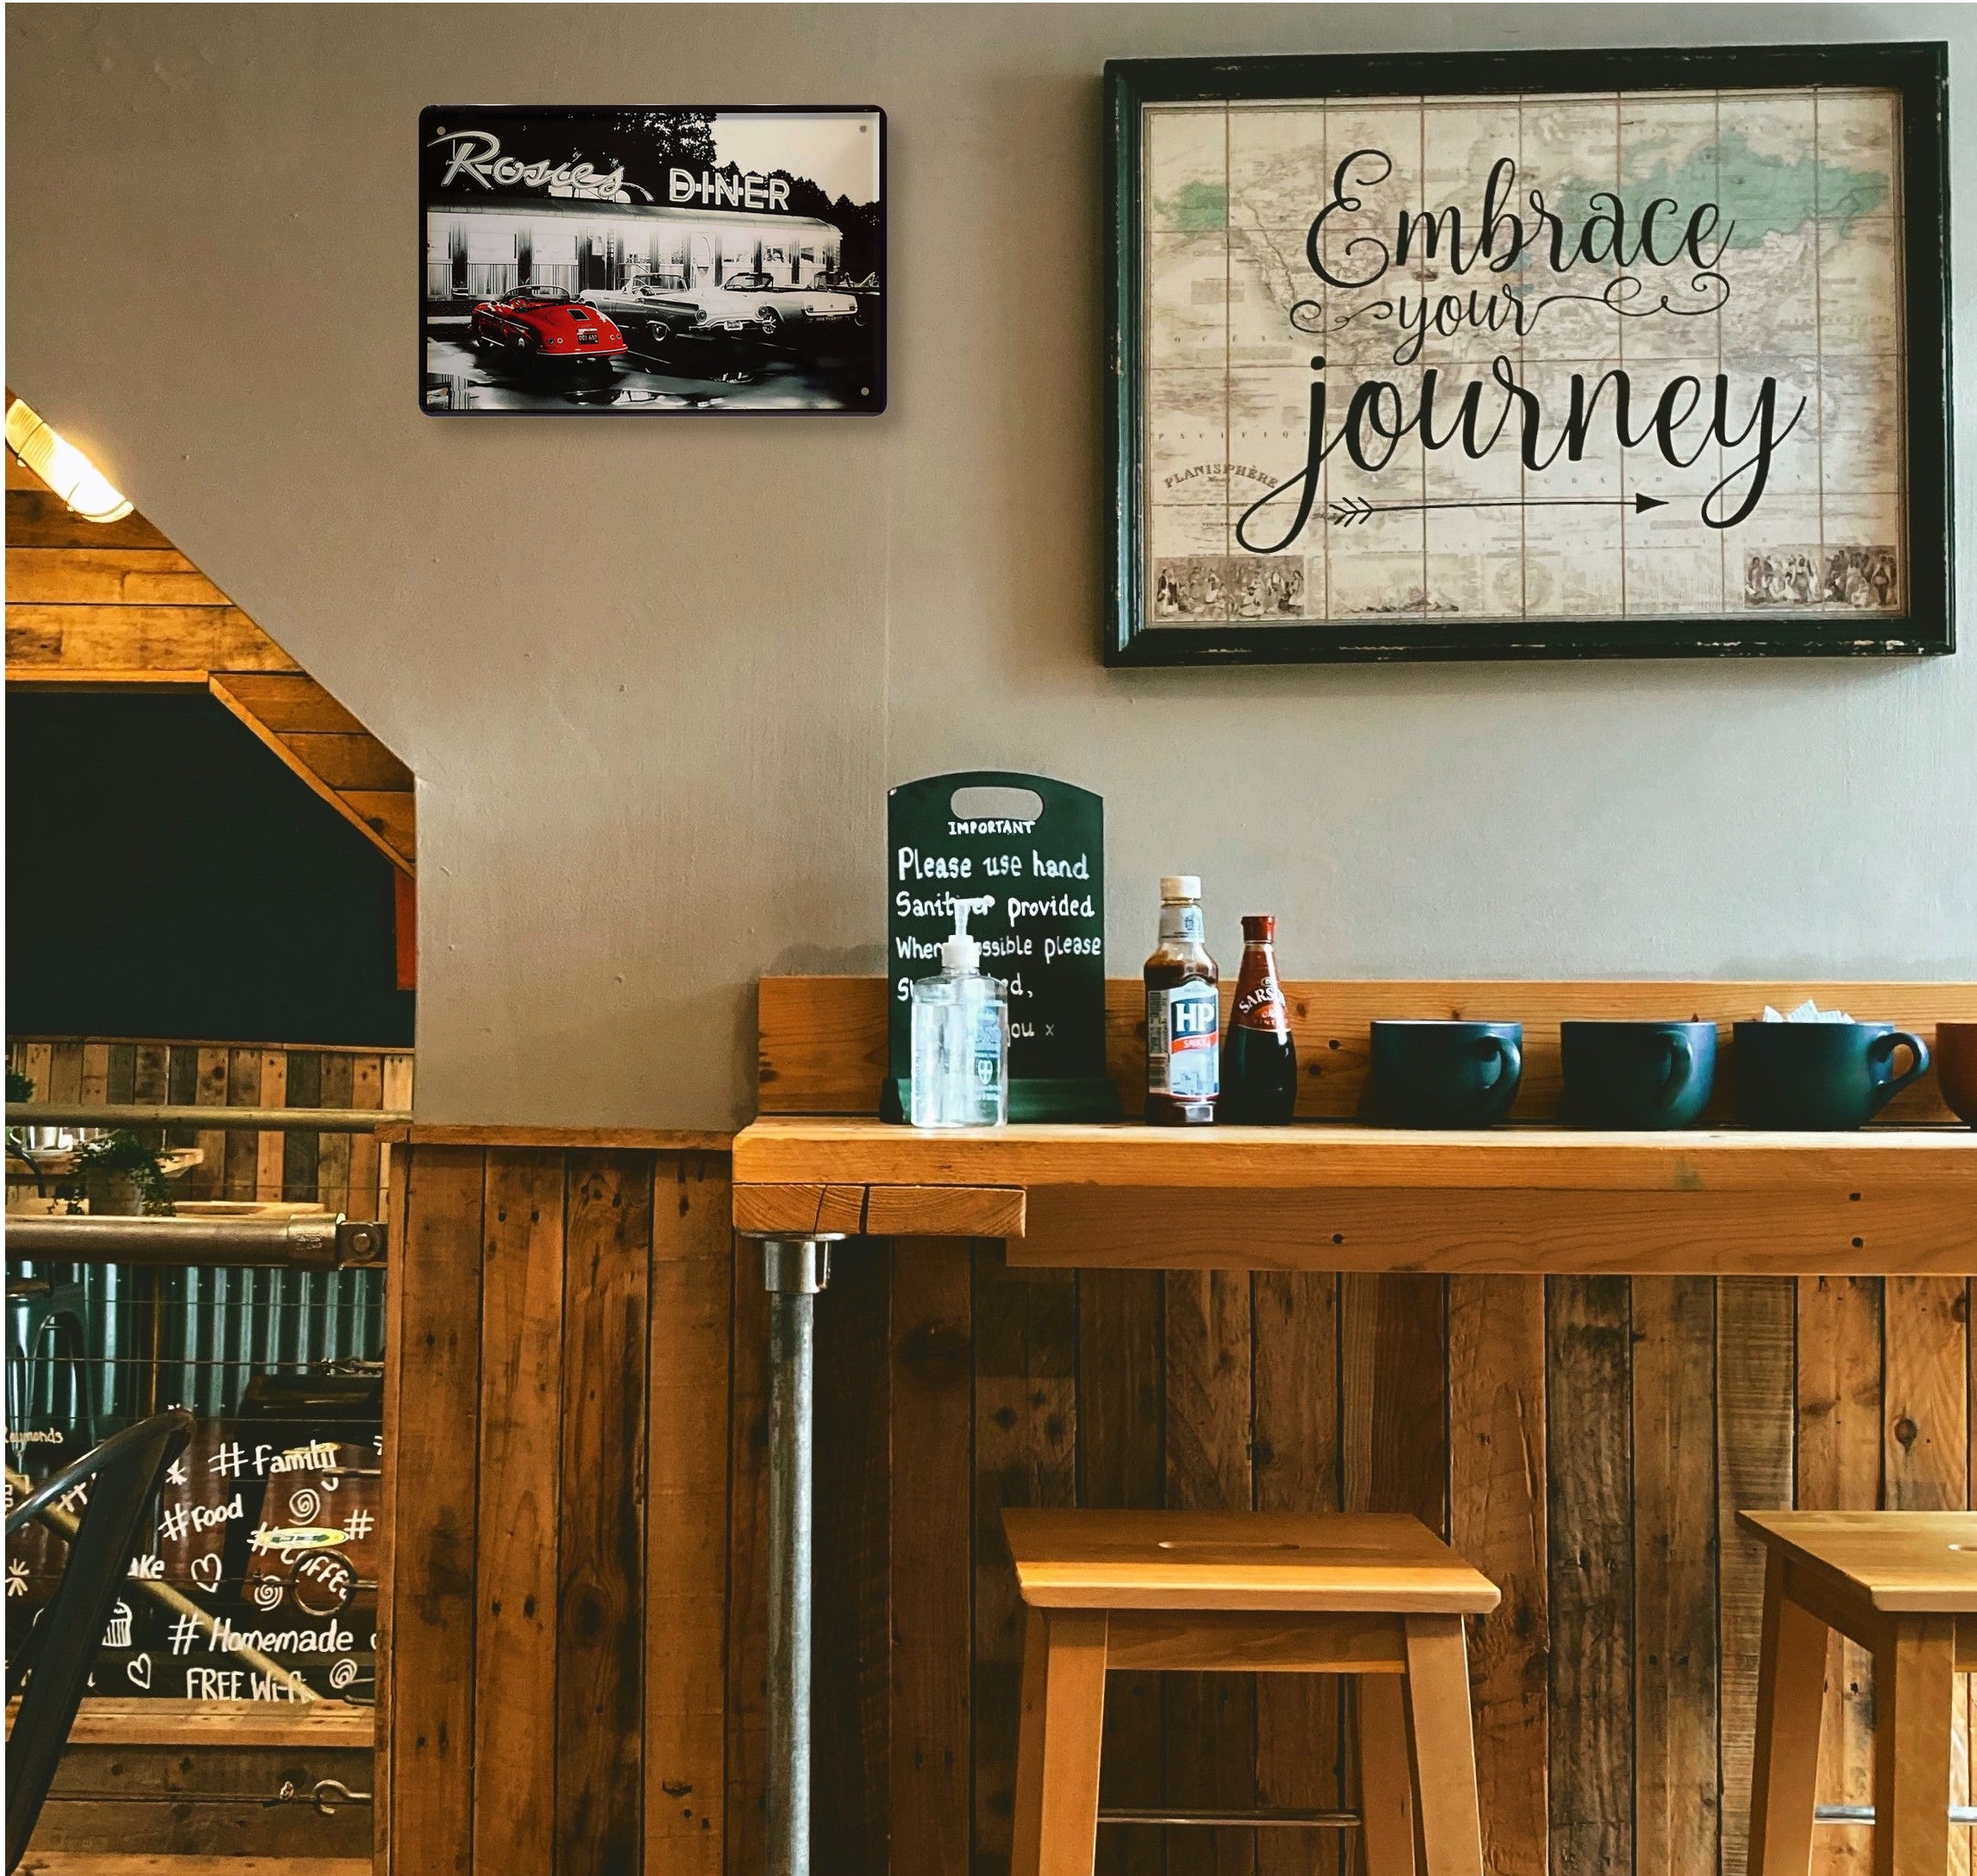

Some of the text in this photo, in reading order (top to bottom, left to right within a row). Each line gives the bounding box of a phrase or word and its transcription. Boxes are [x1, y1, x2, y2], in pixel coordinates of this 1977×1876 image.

[668, 167, 790, 211] DINER
[1305, 148, 1735, 288] Embrace
[1235, 355, 1808, 554] journey
[1164, 463, 1279, 489] PLANISPHÈRE
[947, 820, 1036, 836] IMPORTANT
[898, 846, 1090, 882] Please use hand
[1007, 894, 1095, 928] provided
[1044, 935, 1101, 964] please
[1176, 1002, 1215, 1032] HP
[186, 1666, 245, 1702] FREE
